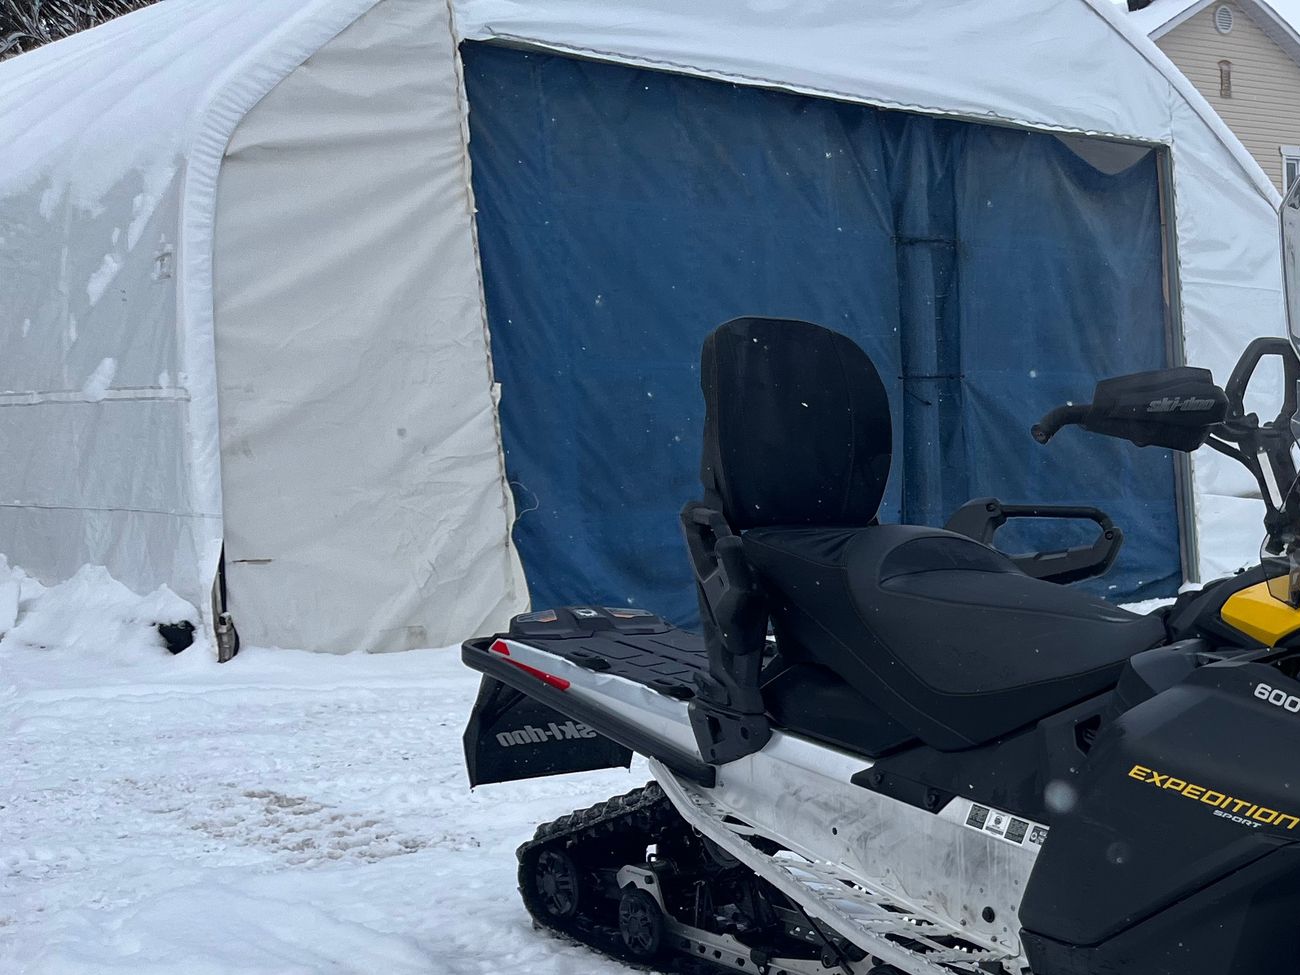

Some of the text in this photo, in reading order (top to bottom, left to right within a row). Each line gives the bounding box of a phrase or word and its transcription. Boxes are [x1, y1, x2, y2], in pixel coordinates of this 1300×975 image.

[1146, 396, 1216, 413] ski-doo
[1128, 764, 1300, 830] EXPEDITION
[1212, 808, 1263, 829] SPORT
